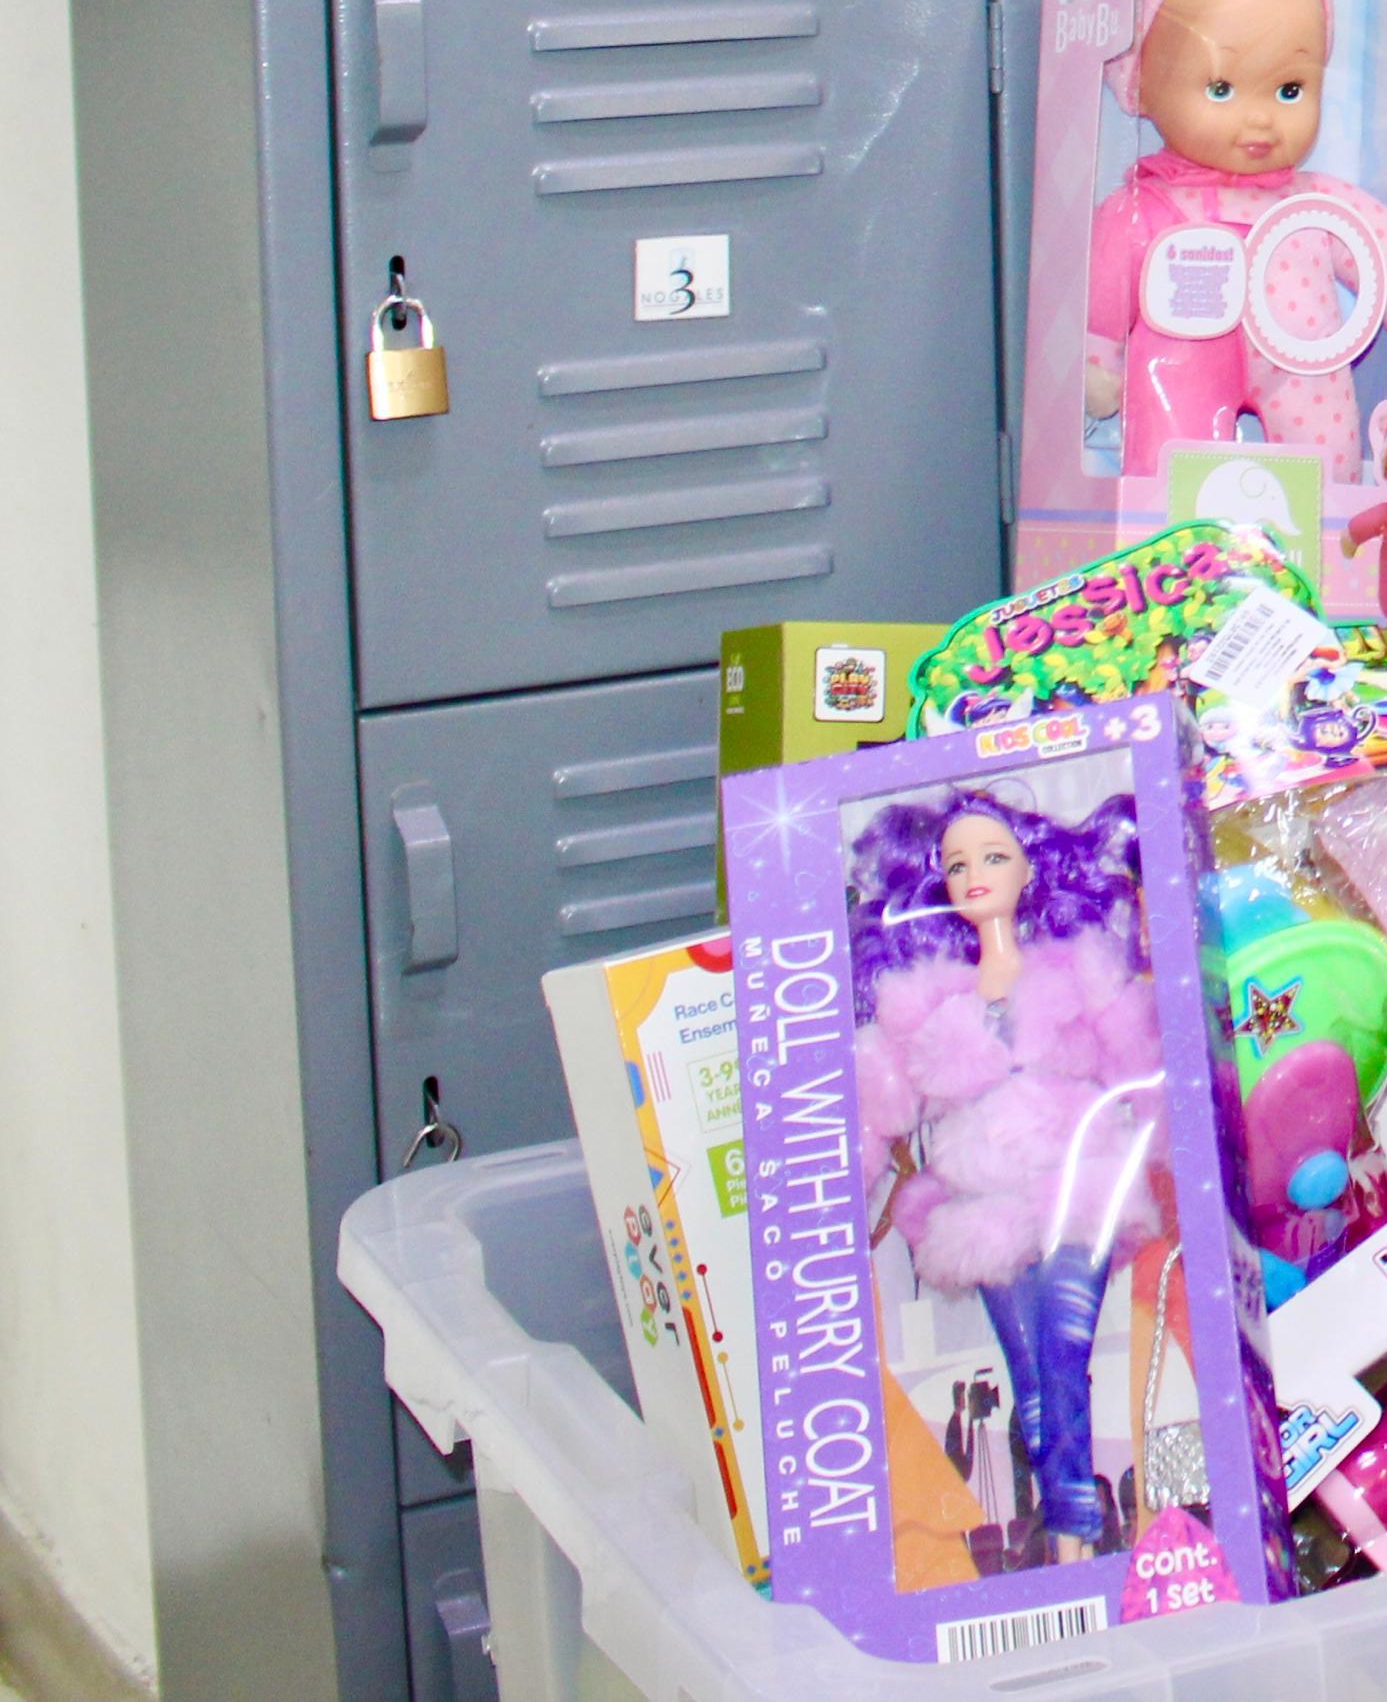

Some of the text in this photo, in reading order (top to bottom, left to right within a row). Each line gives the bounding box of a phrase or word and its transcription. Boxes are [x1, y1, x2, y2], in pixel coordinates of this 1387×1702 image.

[1168, 245, 1233, 260] 6 sonidos!
[641, 287, 723, 305] NOGLES
[669, 268, 695, 316] 3
[967, 541, 1230, 685] Jessica
[991, 574, 1085, 624] JUGUETES
[977, 715, 1087, 757] KIDS COOL
[1102, 706, 1162, 742] +3
[673, 1000, 718, 1021] Race
[743, 937, 802, 1546] MUÑECA SACO PELUCHE
[771, 928, 878, 1533] DOLL WITH FURRY COAT
[624, 1206, 659, 1347] play
[637, 1204, 680, 1347] ever
[1282, 1405, 1315, 1444] OR
[1134, 1541, 1218, 1580] cont.
[1145, 1579, 1217, 1610] 1 set
